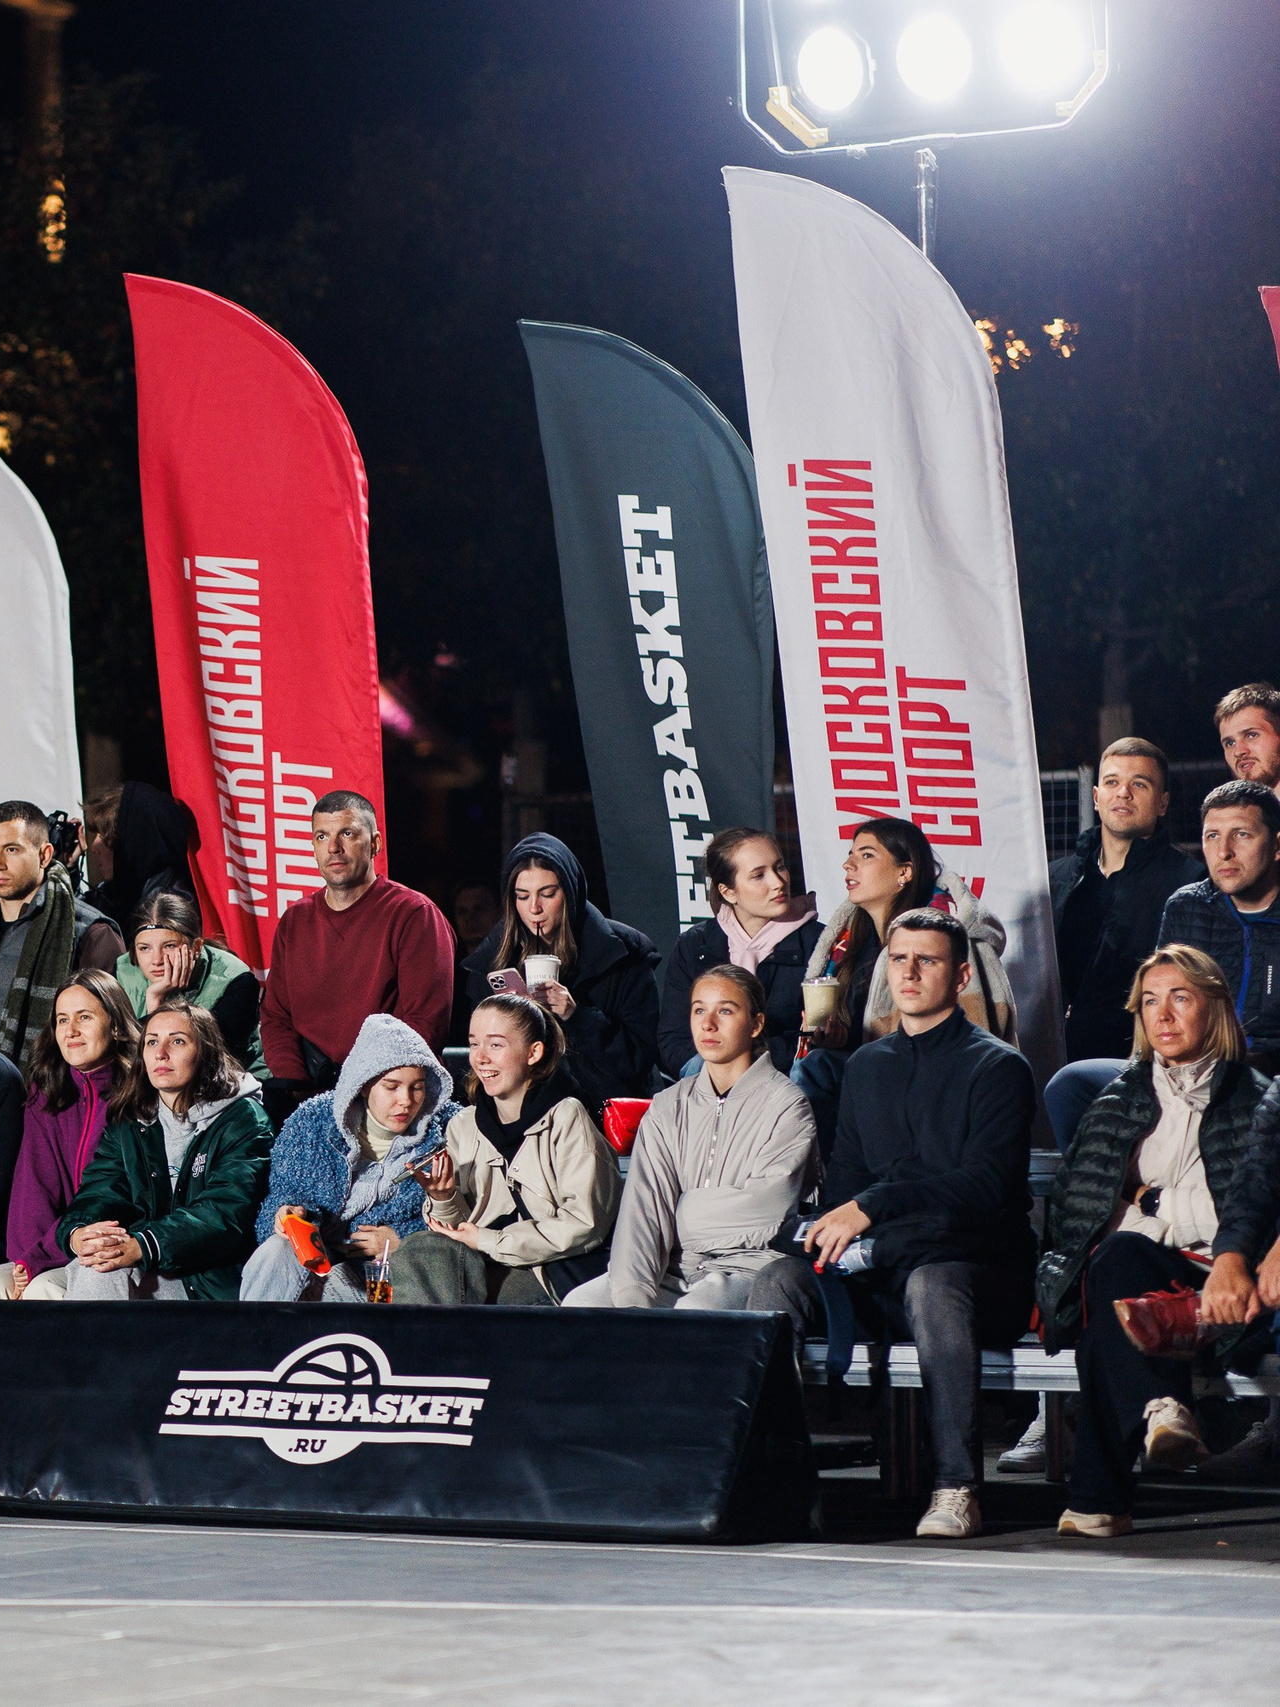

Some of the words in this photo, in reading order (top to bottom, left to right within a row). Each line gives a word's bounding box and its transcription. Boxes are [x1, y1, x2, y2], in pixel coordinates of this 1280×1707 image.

[184, 555, 268, 917] МОСКОВСКИЙ
[617, 494, 715, 933] ETBASKET
[787, 459, 901, 840] МОСКОВСКИЙ
[895, 665, 982, 847] СПОРТ
[165, 1388, 484, 1426] STREETBASKET
[288, 1438, 327, 1453] .RU
